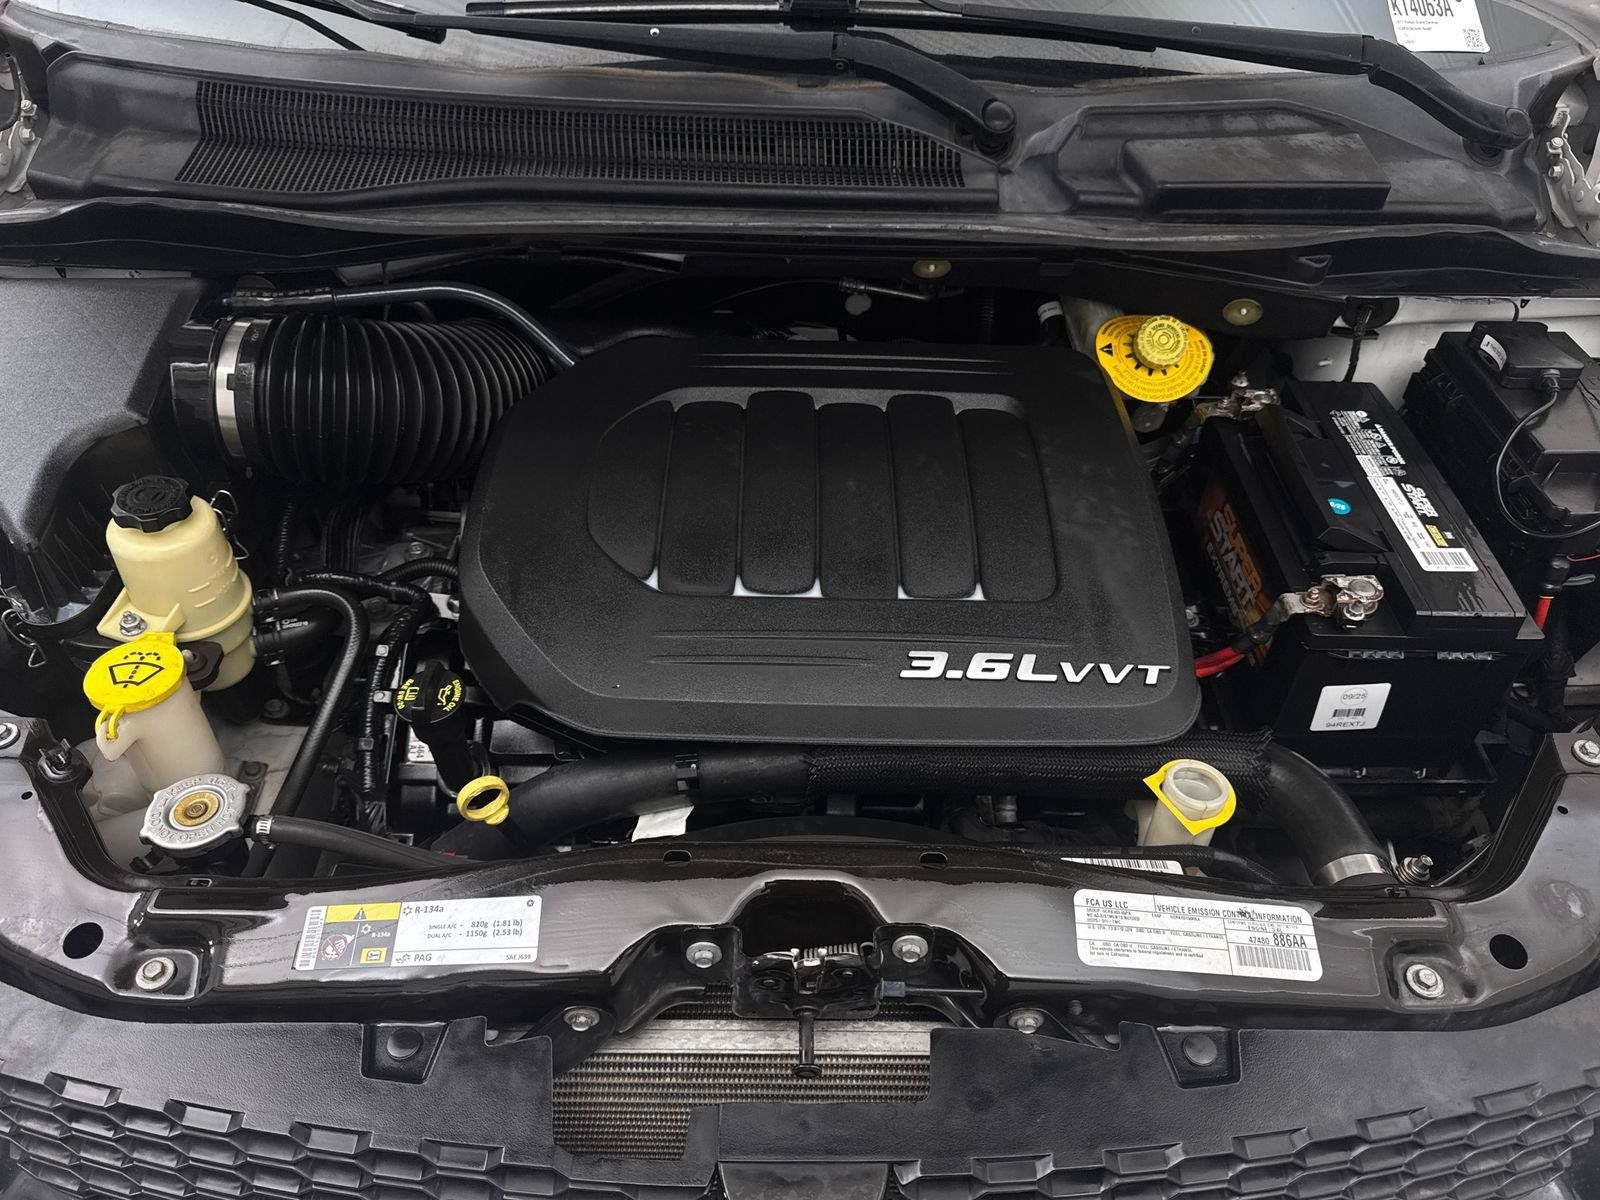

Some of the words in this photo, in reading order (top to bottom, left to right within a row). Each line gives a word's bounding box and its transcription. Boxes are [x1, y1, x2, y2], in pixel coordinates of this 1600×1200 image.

[1401, 482, 1429, 516] START
[1414, 487, 1439, 517] SUPER
[1208, 509, 1254, 609] START
[452, 679, 462, 702] ENGINE
[442, 701, 456, 712] OIL
[415, 905, 444, 914] R-134a
[1086, 898, 1100, 906] FCA
[1102, 900, 1113, 908] US
[1115, 900, 1128, 909] LLC
[1157, 904, 1186, 914] VEHICLE
[1188, 906, 1221, 917] EMISSION
[1255, 911, 1303, 924] INFORMATION
[471, 920, 489, 929] 820g
[493, 920, 511, 928] (1.81
[512, 919, 523, 927] lb)
[466, 930, 488, 938] 1150g
[493, 929, 511, 937] (2.53
[512, 928, 523, 936] lb)
[1249, 936, 1270, 945] 47480
[1272, 933, 1307, 948] 886AA
[414, 953, 432, 962] PAG
